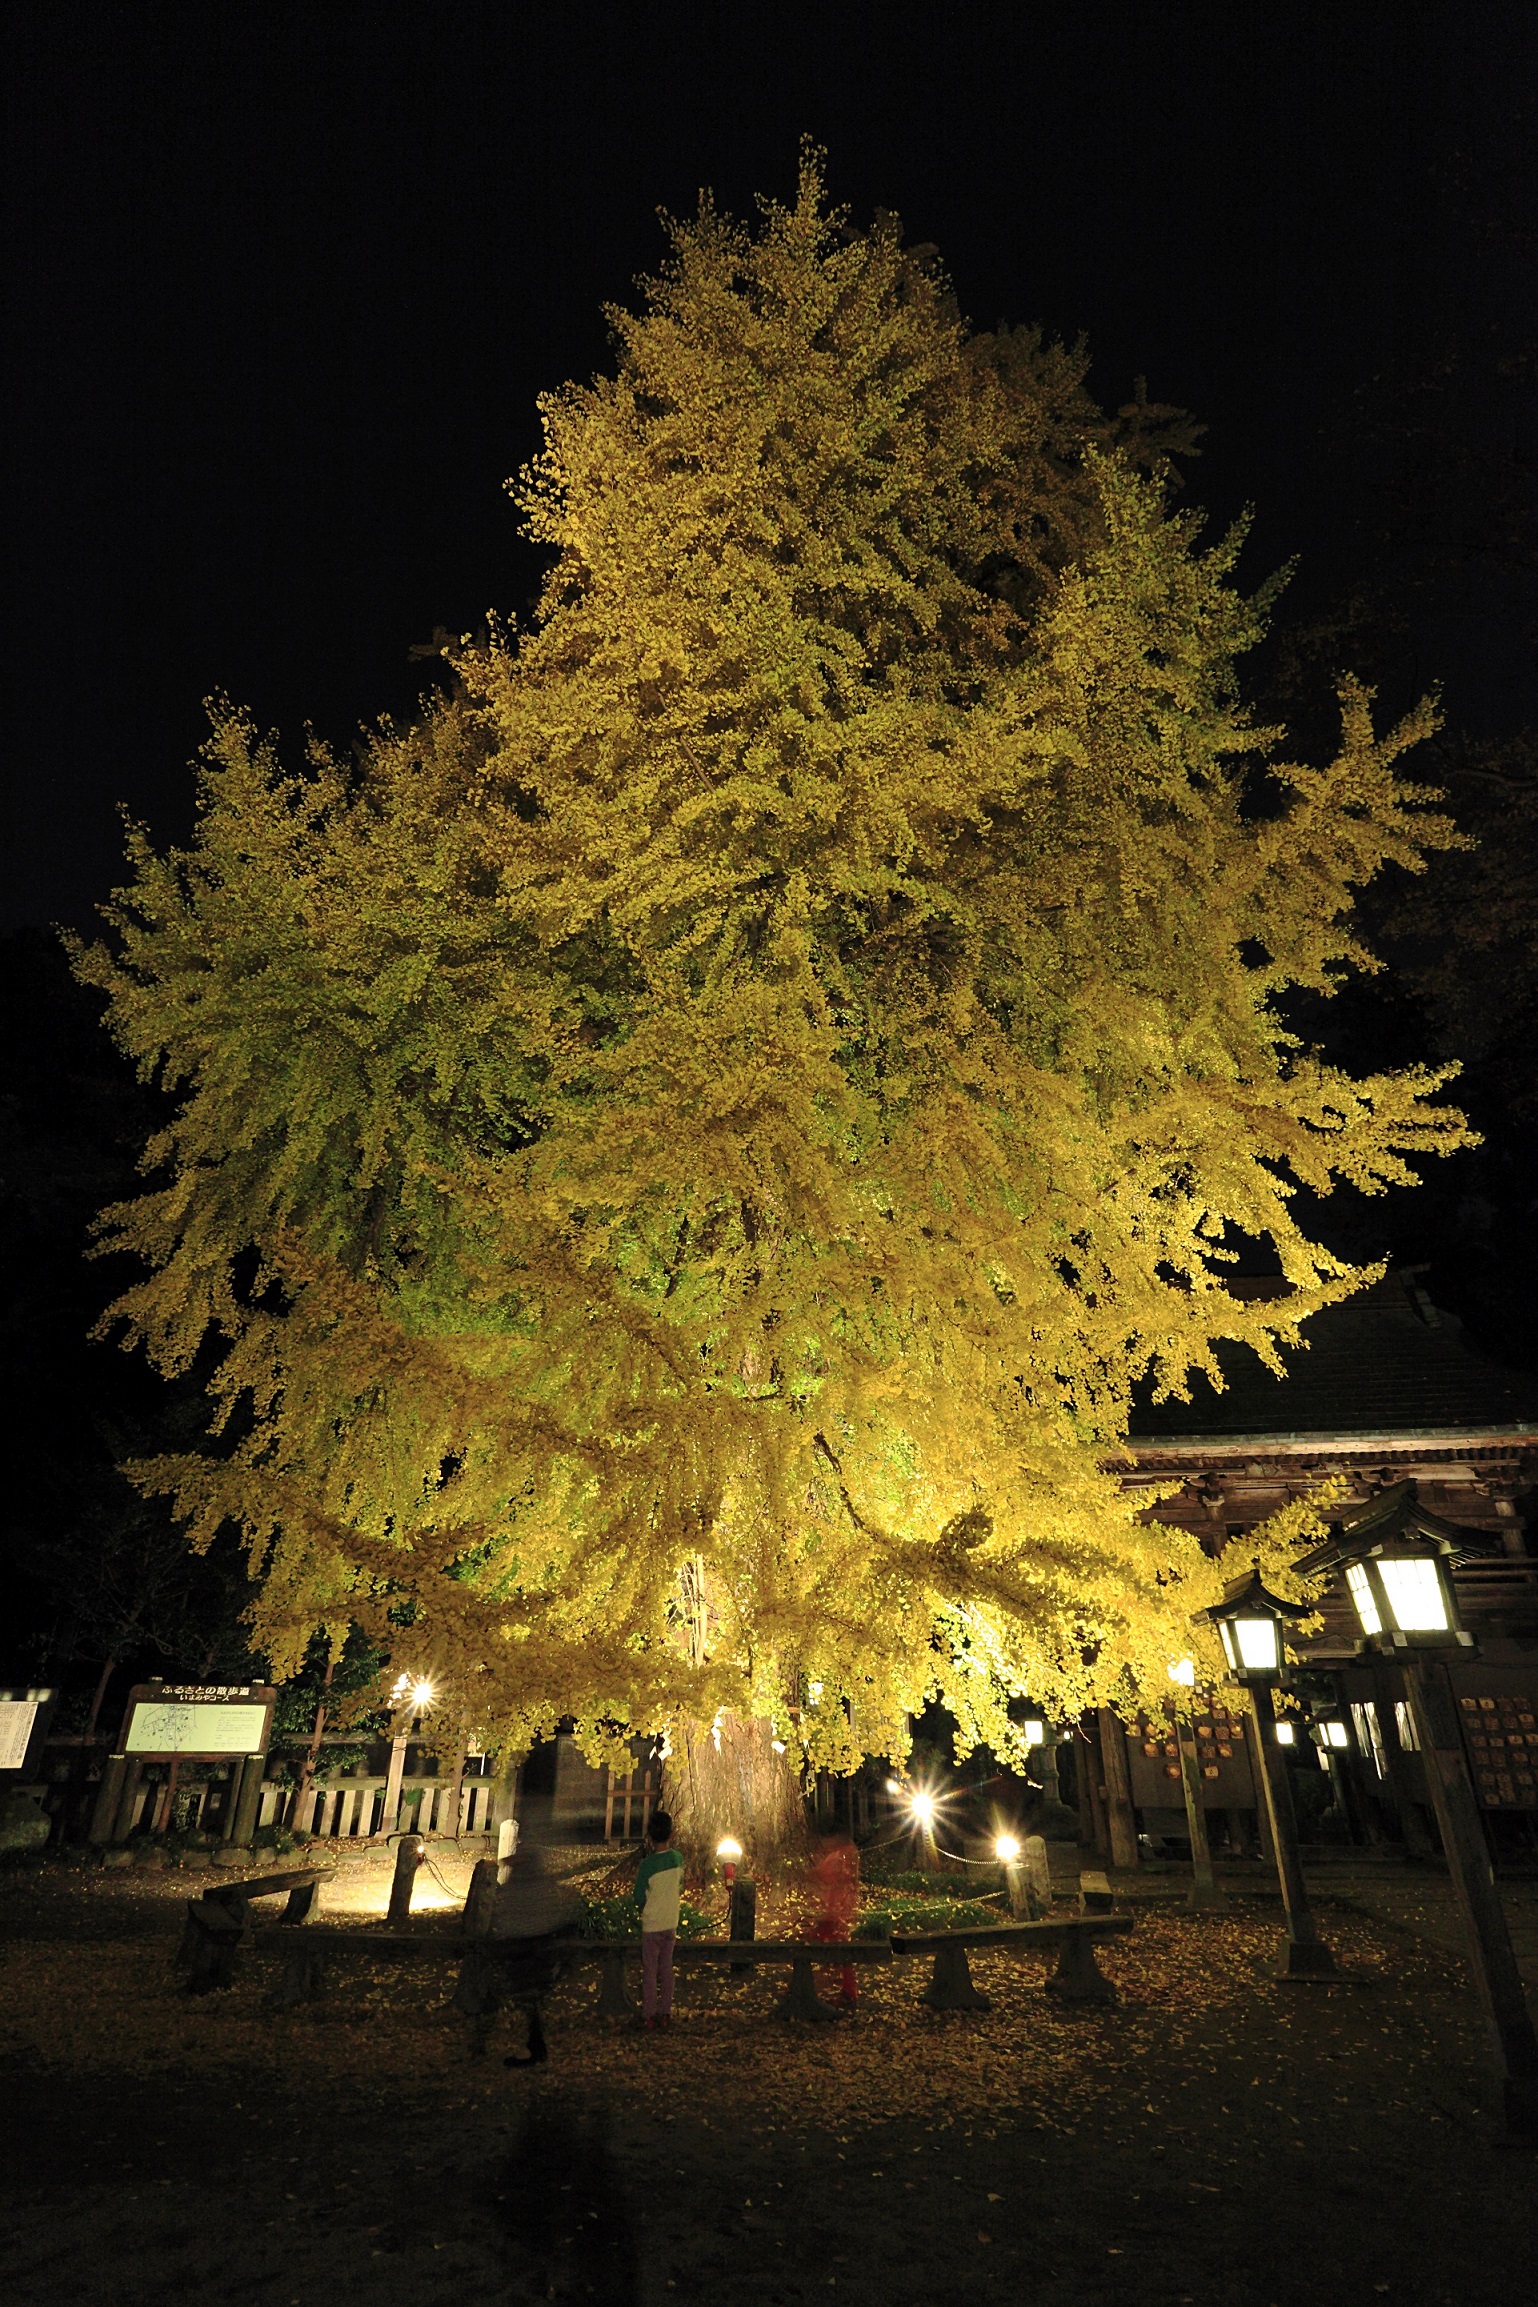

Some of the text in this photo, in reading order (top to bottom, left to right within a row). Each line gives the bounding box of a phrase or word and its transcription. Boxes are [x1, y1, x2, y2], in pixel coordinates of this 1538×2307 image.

[162, 1685, 250, 1696] ふるさとの散歩道
